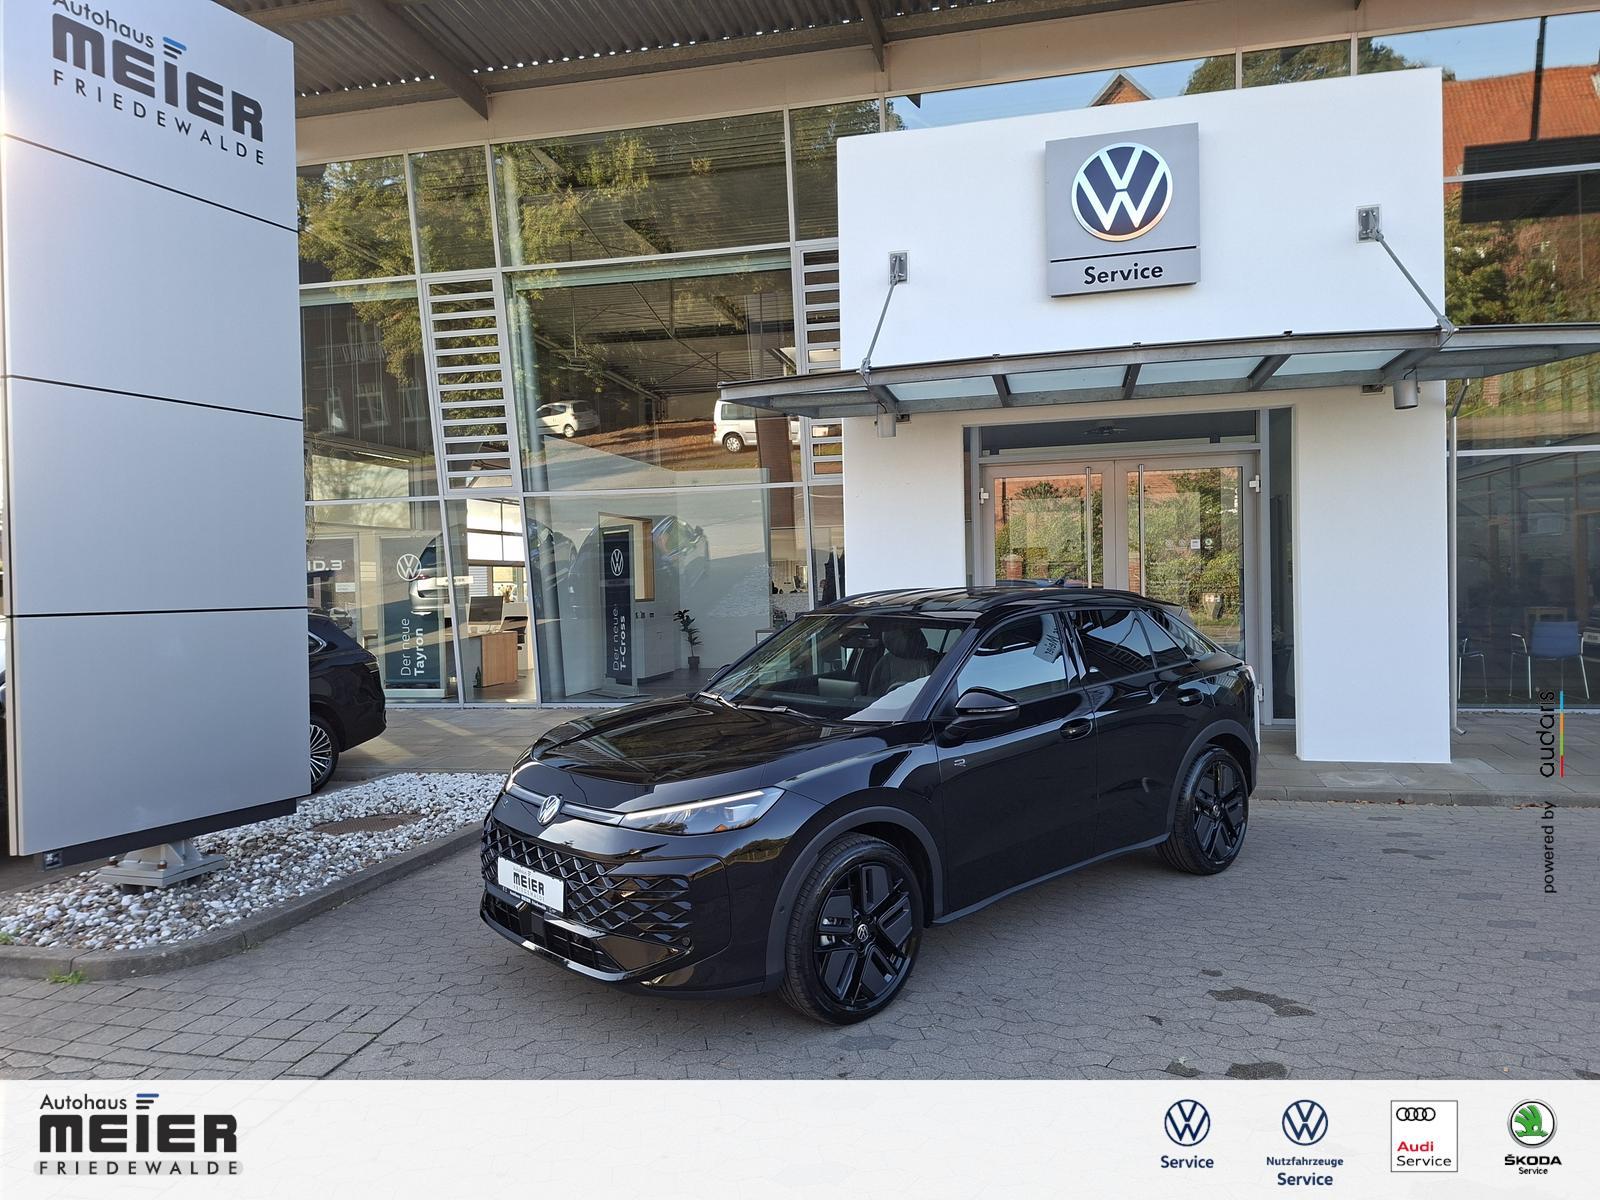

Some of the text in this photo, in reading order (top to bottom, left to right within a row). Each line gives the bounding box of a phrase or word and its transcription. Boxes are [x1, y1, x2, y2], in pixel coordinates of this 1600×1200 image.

[52, 0, 154, 49] Autohaus
[52, 13, 263, 142] MEIER
[53, 70, 264, 165] FRIEDEWALDE
[1071, 142, 1173, 242] VW
[1084, 262, 1164, 285] Service
[307, 559, 343, 572] ID.3
[400, 618, 412, 676] Der neue
[414, 627, 427, 677] Tayron
[619, 616, 627, 671] T-Cross
[513, 871, 544, 896] MEIER
